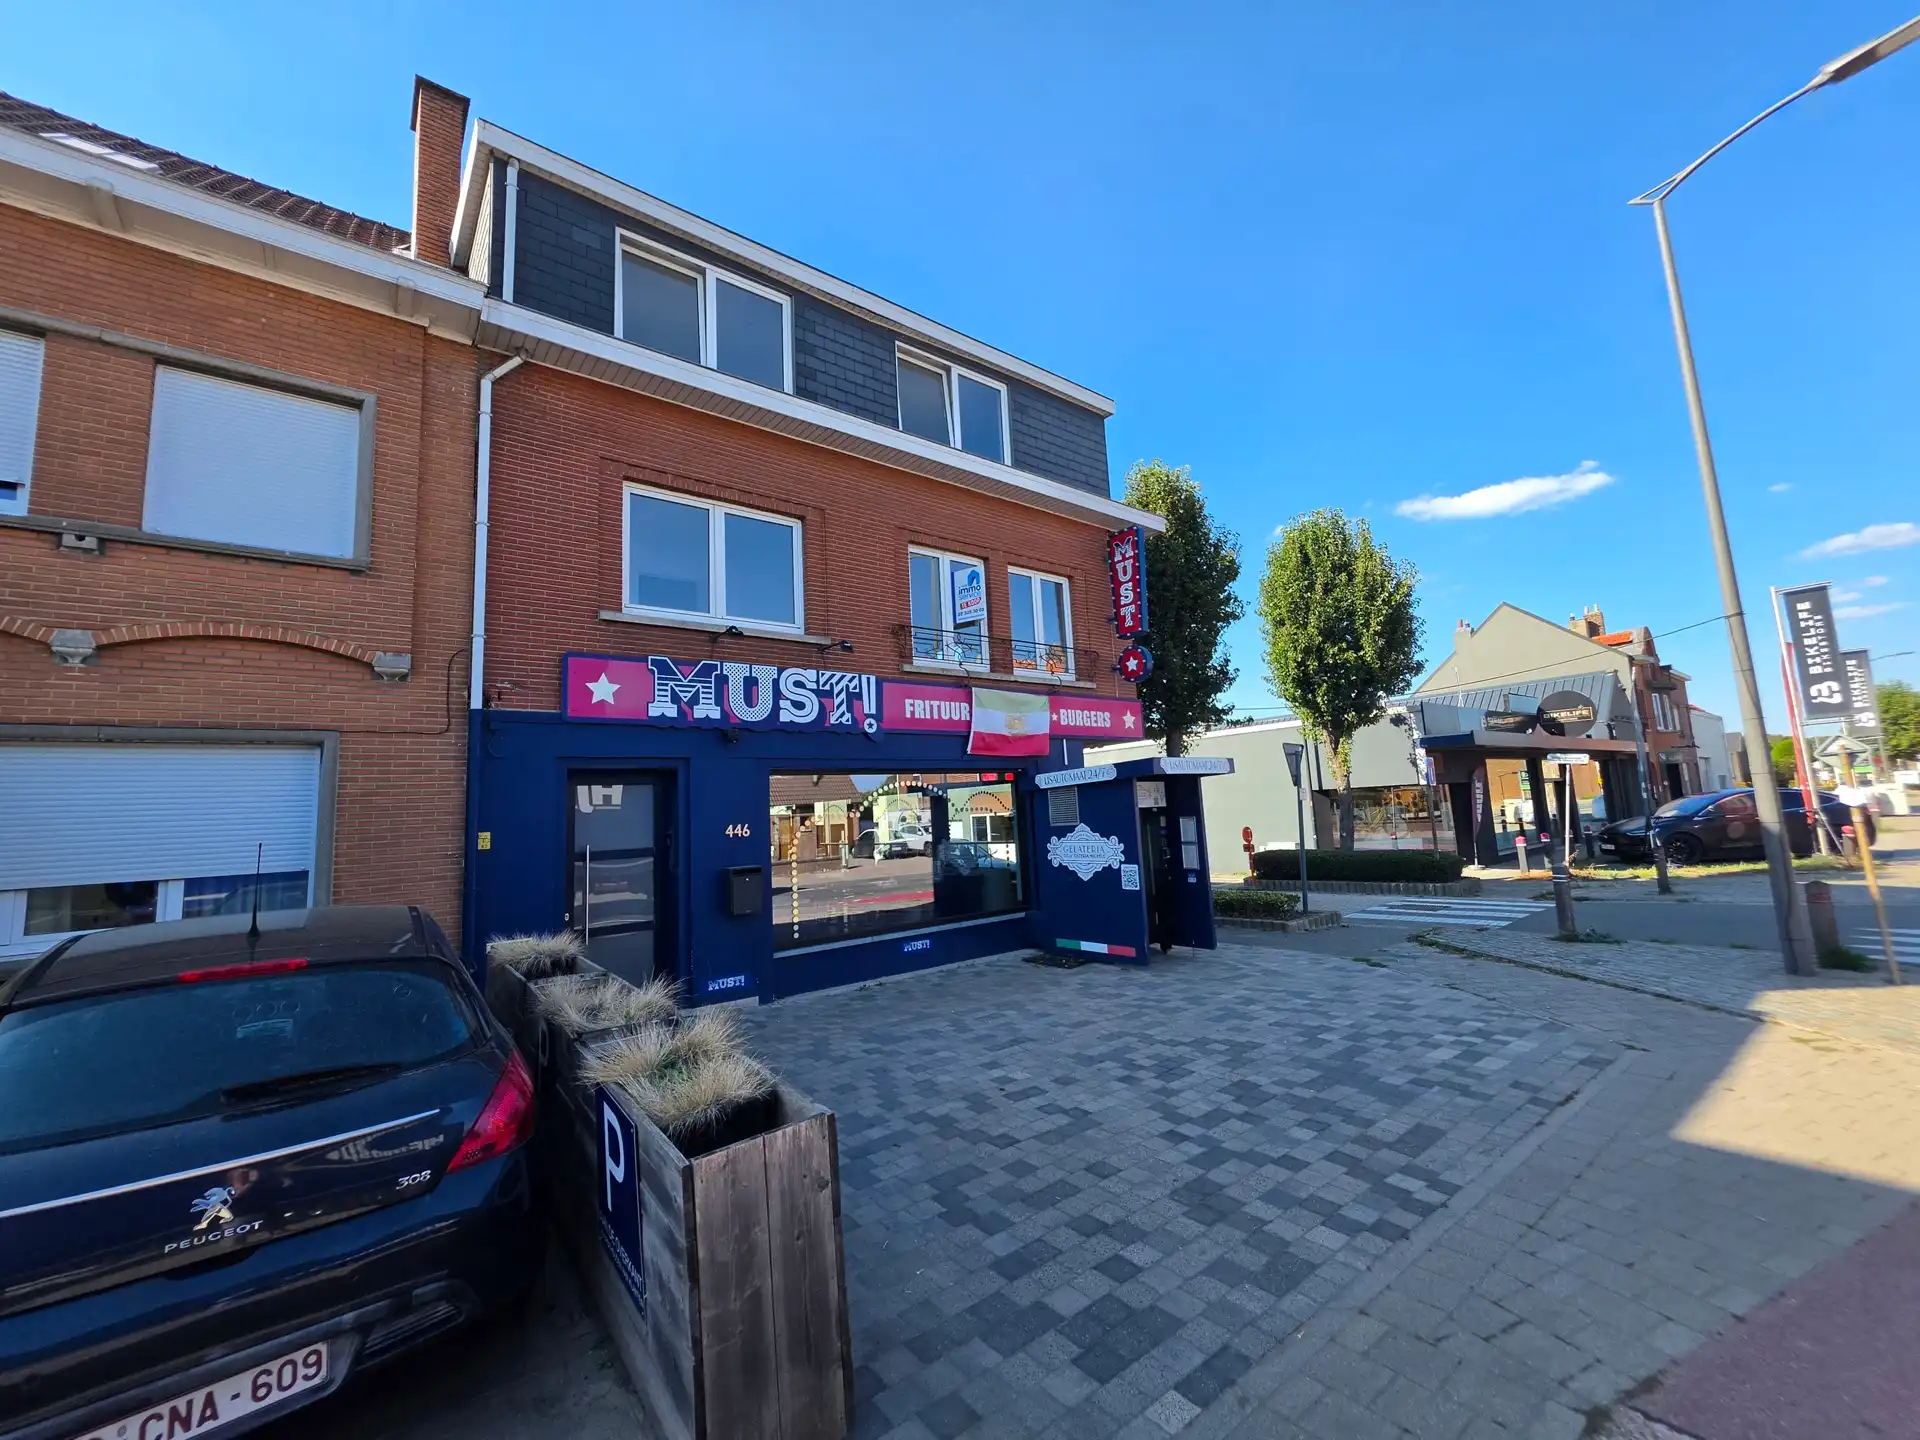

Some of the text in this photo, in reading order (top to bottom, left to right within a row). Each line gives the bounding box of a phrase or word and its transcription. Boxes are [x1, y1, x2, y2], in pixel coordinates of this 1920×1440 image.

[958, 584, 981, 595] immo
[1113, 535, 1136, 627] MUST
[1796, 601, 1824, 675] BIKELIFE
[648, 656, 878, 734] MUST!
[905, 699, 970, 721] FRITUUR
[1060, 708, 1111, 728] BURGERS
[725, 823, 751, 838] 446
[1062, 844, 1106, 854] GELATERIA
[903, 939, 930, 952] MUST!
[708, 975, 745, 991] MUST!
[604, 1101, 625, 1212] P
[396, 1169, 432, 1191] 308
[163, 1219, 264, 1254] PEUGEOT
